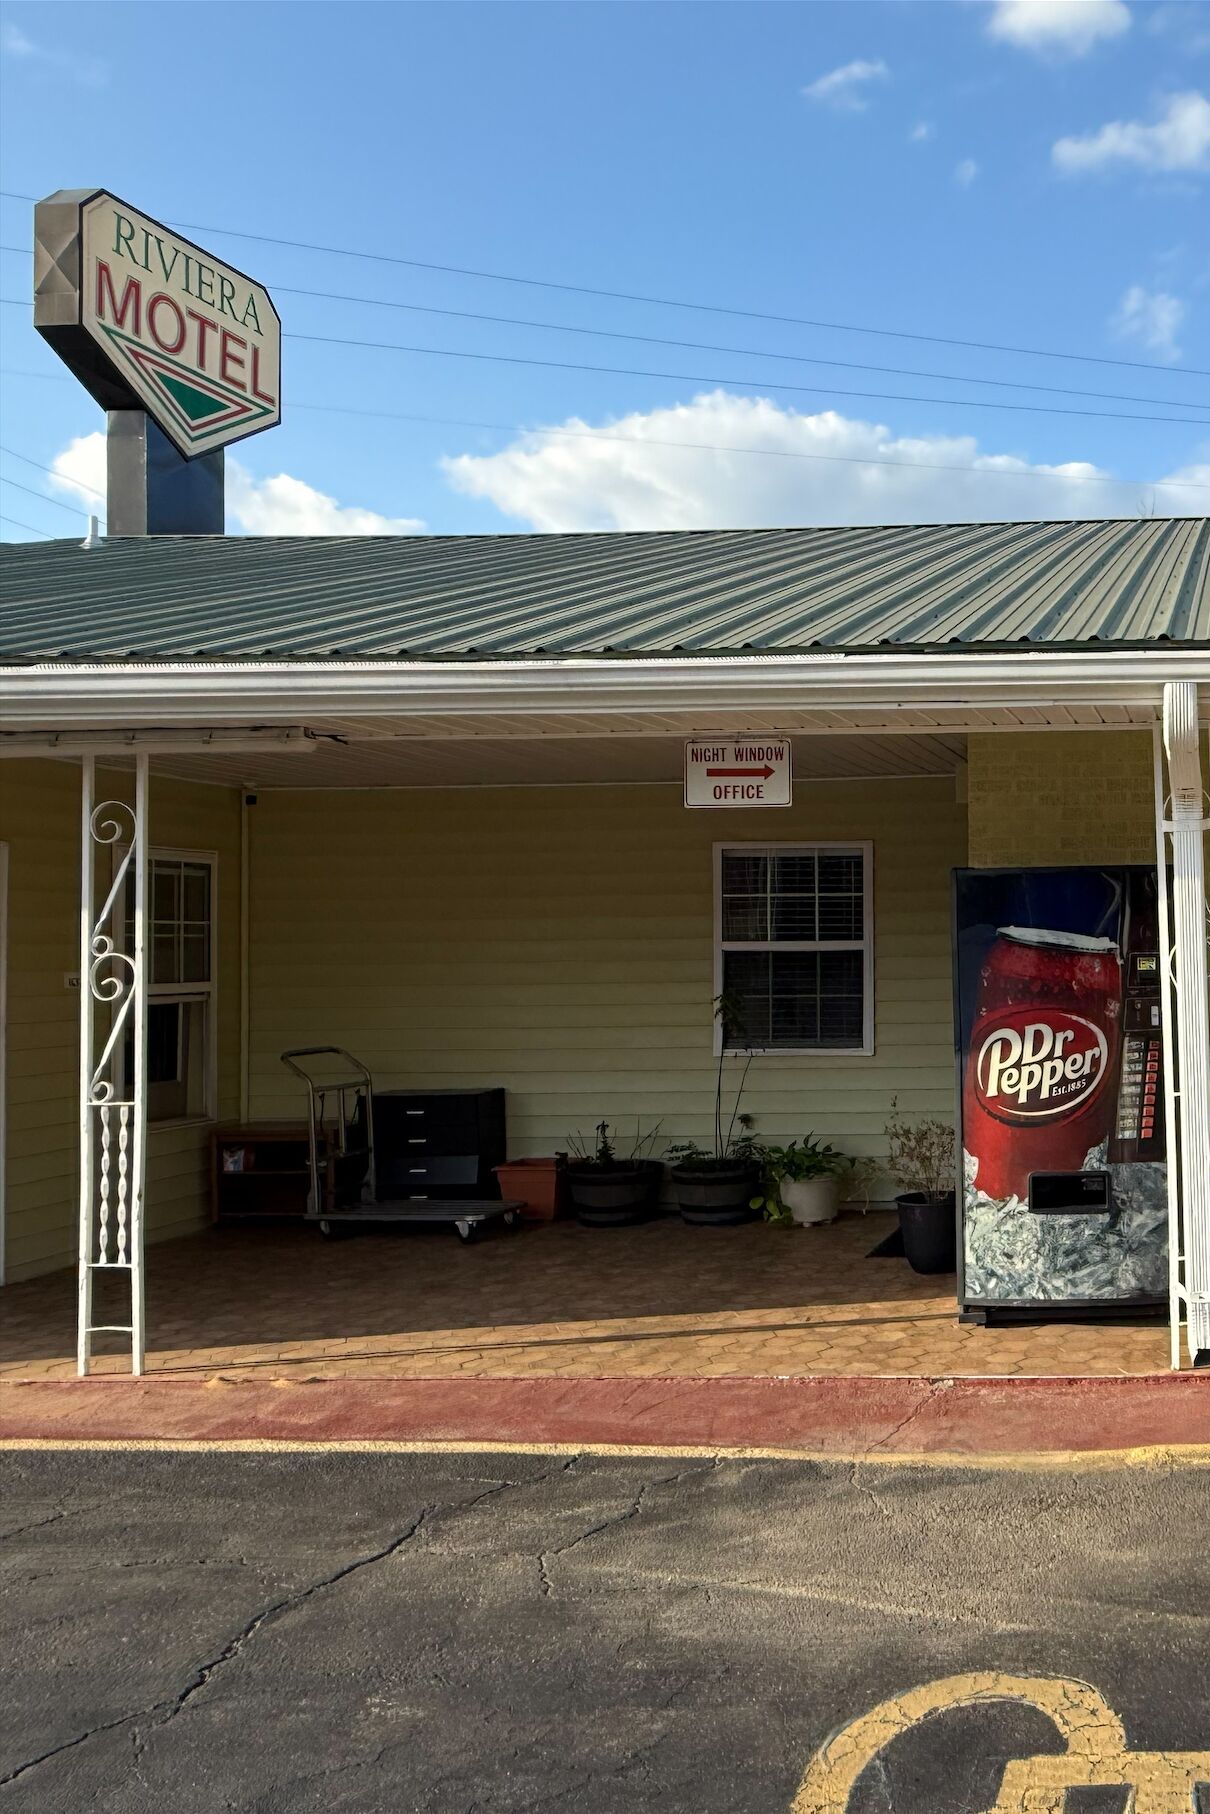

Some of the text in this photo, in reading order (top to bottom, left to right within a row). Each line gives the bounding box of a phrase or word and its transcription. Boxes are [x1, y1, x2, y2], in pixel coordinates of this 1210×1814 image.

[112, 210, 264, 337] RIVIERA
[95, 256, 276, 408] MOTEL
[691, 746, 784, 762] NIGHT WINDOW
[713, 784, 765, 800] OFFICE
[977, 1023, 1101, 1105] Dr Pepper
